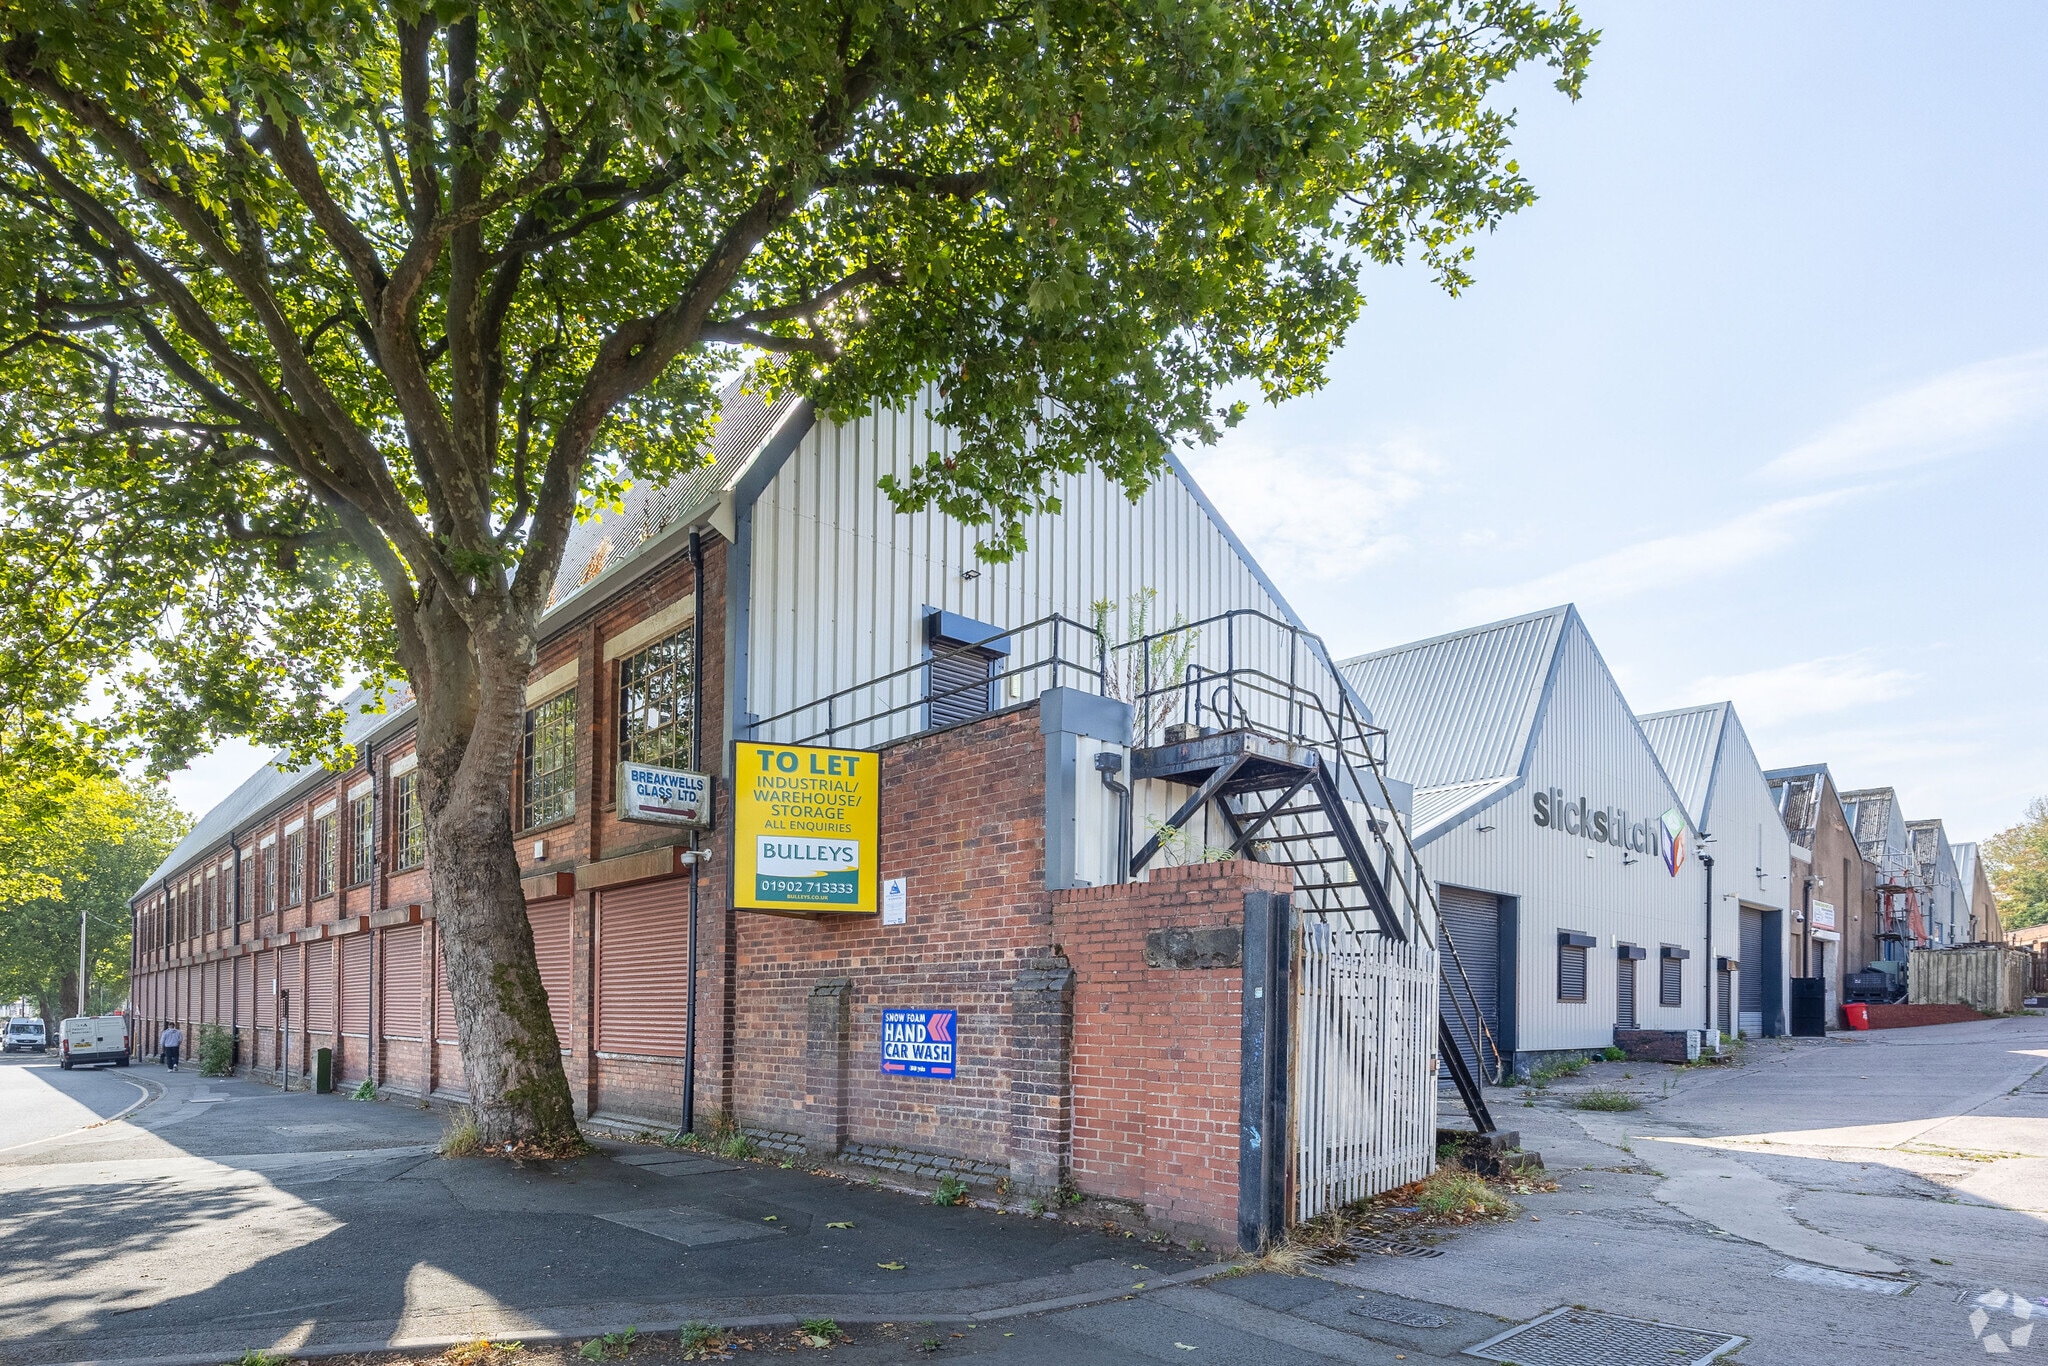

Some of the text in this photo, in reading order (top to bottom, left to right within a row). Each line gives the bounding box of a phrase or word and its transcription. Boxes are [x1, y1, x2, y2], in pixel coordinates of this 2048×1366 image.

[756, 749, 860, 777] TO LET
[757, 776, 859, 793] INDUSTRIAL/
[637, 784, 699, 803] GLASS LTD.
[753, 790, 862, 807] WAREHOUSE/
[771, 804, 844, 820] STORAGE
[764, 819, 852, 833] ALL ENQUIRIES
[1533, 786, 1658, 856] slickstitch
[763, 843, 853, 862] BULLEYS
[762, 880, 853, 894] 01902 713333
[786, 893, 829, 901] BULLEYS.CO.UK
[885, 1013, 926, 1023] SNOW FOAM
[885, 1023, 927, 1043] HAND
[885, 1043, 950, 1061] CAR WASH
